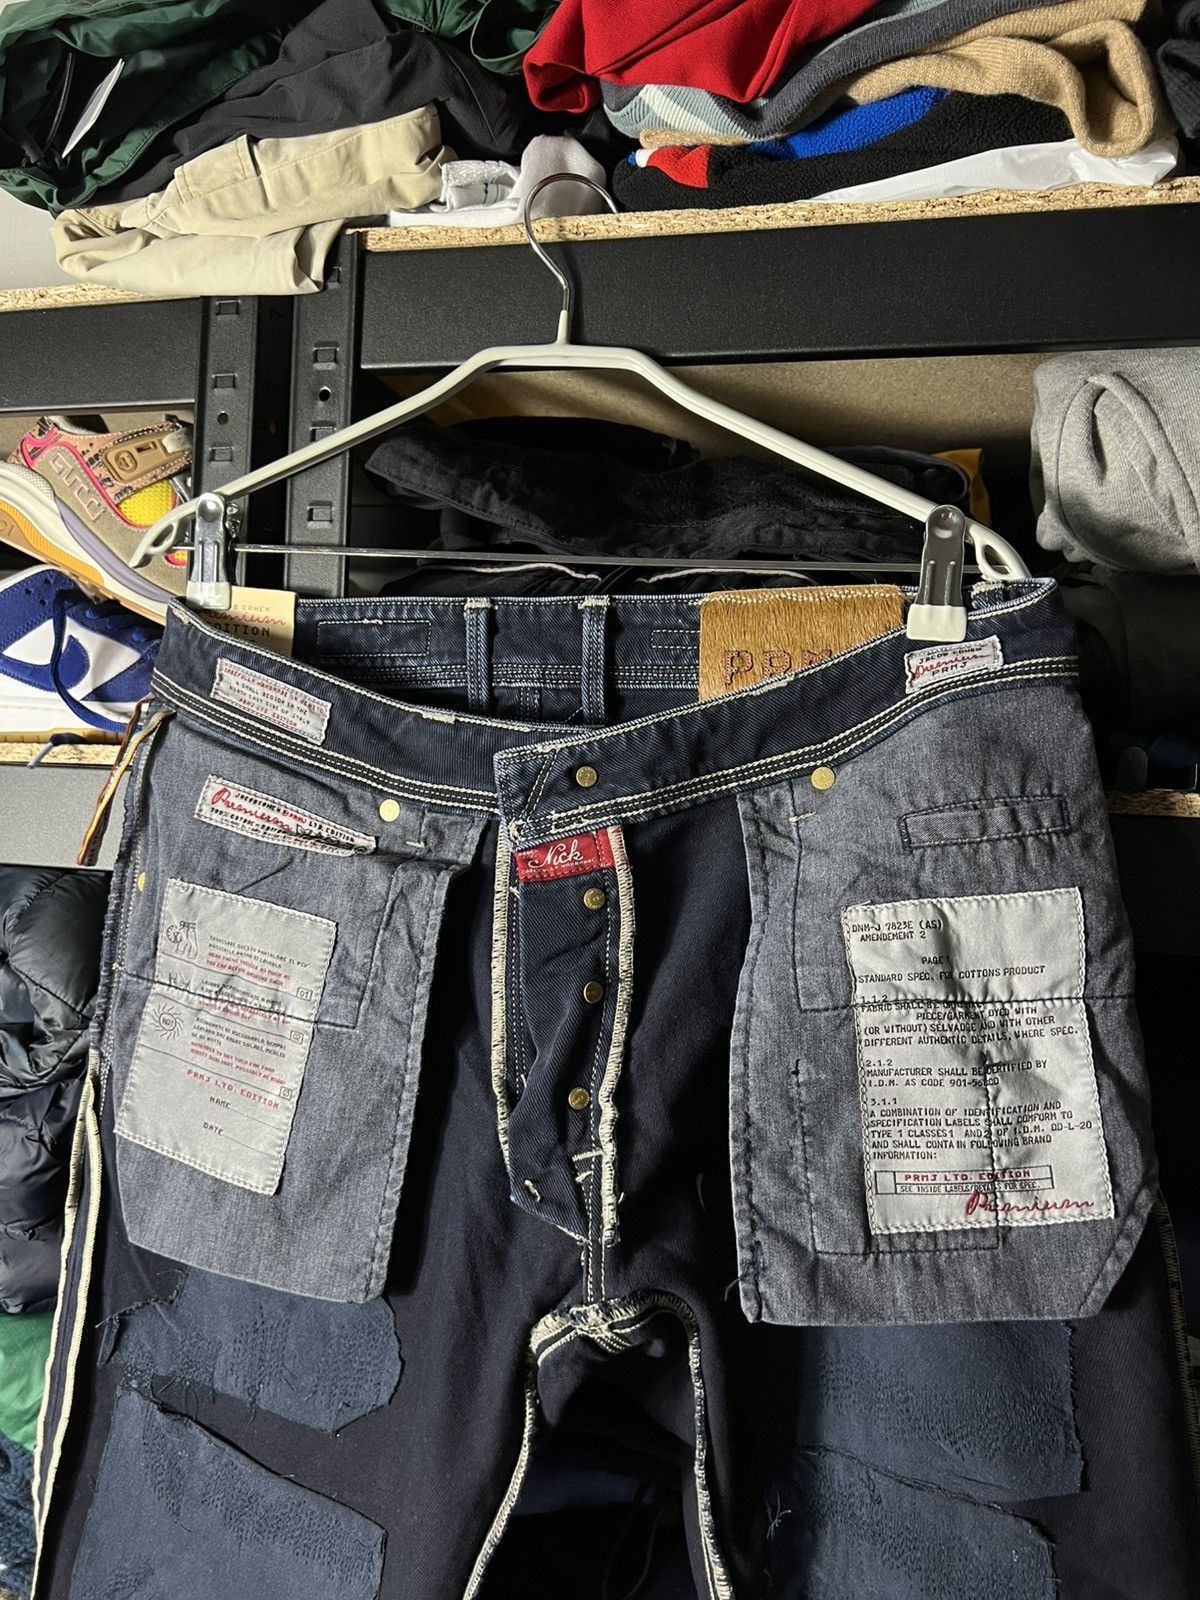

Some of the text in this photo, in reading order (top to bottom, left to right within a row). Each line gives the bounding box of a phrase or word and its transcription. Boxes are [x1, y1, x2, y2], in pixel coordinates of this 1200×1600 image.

[931, 661, 968, 676] PRMJ
[528, 839, 584, 868] Nick
[852, 924, 881, 933] DNM-J
[919, 919, 944, 930] (AS)
[860, 930, 926, 942] AMENDEMENT 2
[921, 956, 943, 965] PAGE
[858, 973, 903, 983] STANDARD
[958, 969, 1001, 979] COTTONS
[1003, 965, 1045, 976] PRODUCT
[861, 1003, 893, 1013] FABRIC
[988, 1007, 1010, 1017] DYED
[1015, 1006, 1037, 1015] WITH
[864, 1015, 1055, 1036] (OR WITHOUT) SELVADGE AND WITH OTHER
[864, 1036, 914, 1047] DIFFERENT
[918, 1035, 967, 1046] AUTHENTIC
[1014, 1028, 1046, 1039] WHERE
[1050, 1025, 1078, 1037] SPEC.
[866, 1059, 893, 1067] 2.1.2
[867, 1067, 933, 1077] MANUFACTURER
[938, 1067, 968, 1076] SHALL
[972, 1067, 983, 1076] BE
[1036, 1060, 1047, 1069] BY
[187, 1069, 211, 1083] PRMJ
[240, 1089, 280, 1110] EDITION
[868, 1079, 899, 1088] I.D.M.
[905, 1078, 917, 1087] AS
[921, 1078, 945, 1087] CODE
[209, 1096, 231, 1110] NAME
[870, 1100, 1061, 1118] A COMBINATION OF IDENTIFICATION AND
[870, 1118, 942, 1128] SPECIFICATION
[945, 1118, 980, 1127] LABELS
[1061, 1110, 1073, 1120] TO
[203, 1122, 224, 1136] DATE
[870, 1129, 893, 1139] TYPE
[898, 1129, 903, 1138] 1
[996, 1127, 1009, 1137] OF
[1051, 1120, 1092, 1132] DD-L-20
[872, 1140, 889, 1149] AND
[893, 1140, 920, 1149] SHALL
[1022, 1134, 1052, 1146] BRAND
[873, 1150, 937, 1160] INFORMATION:
[905, 1173, 937, 1182] PRMJ
[944, 1173, 973, 1182] LTD.
[917, 1184, 942, 1193] INSIDE
[1004, 1181, 1018, 1190] FOR
[965, 1190, 1094, 1217] Premium
